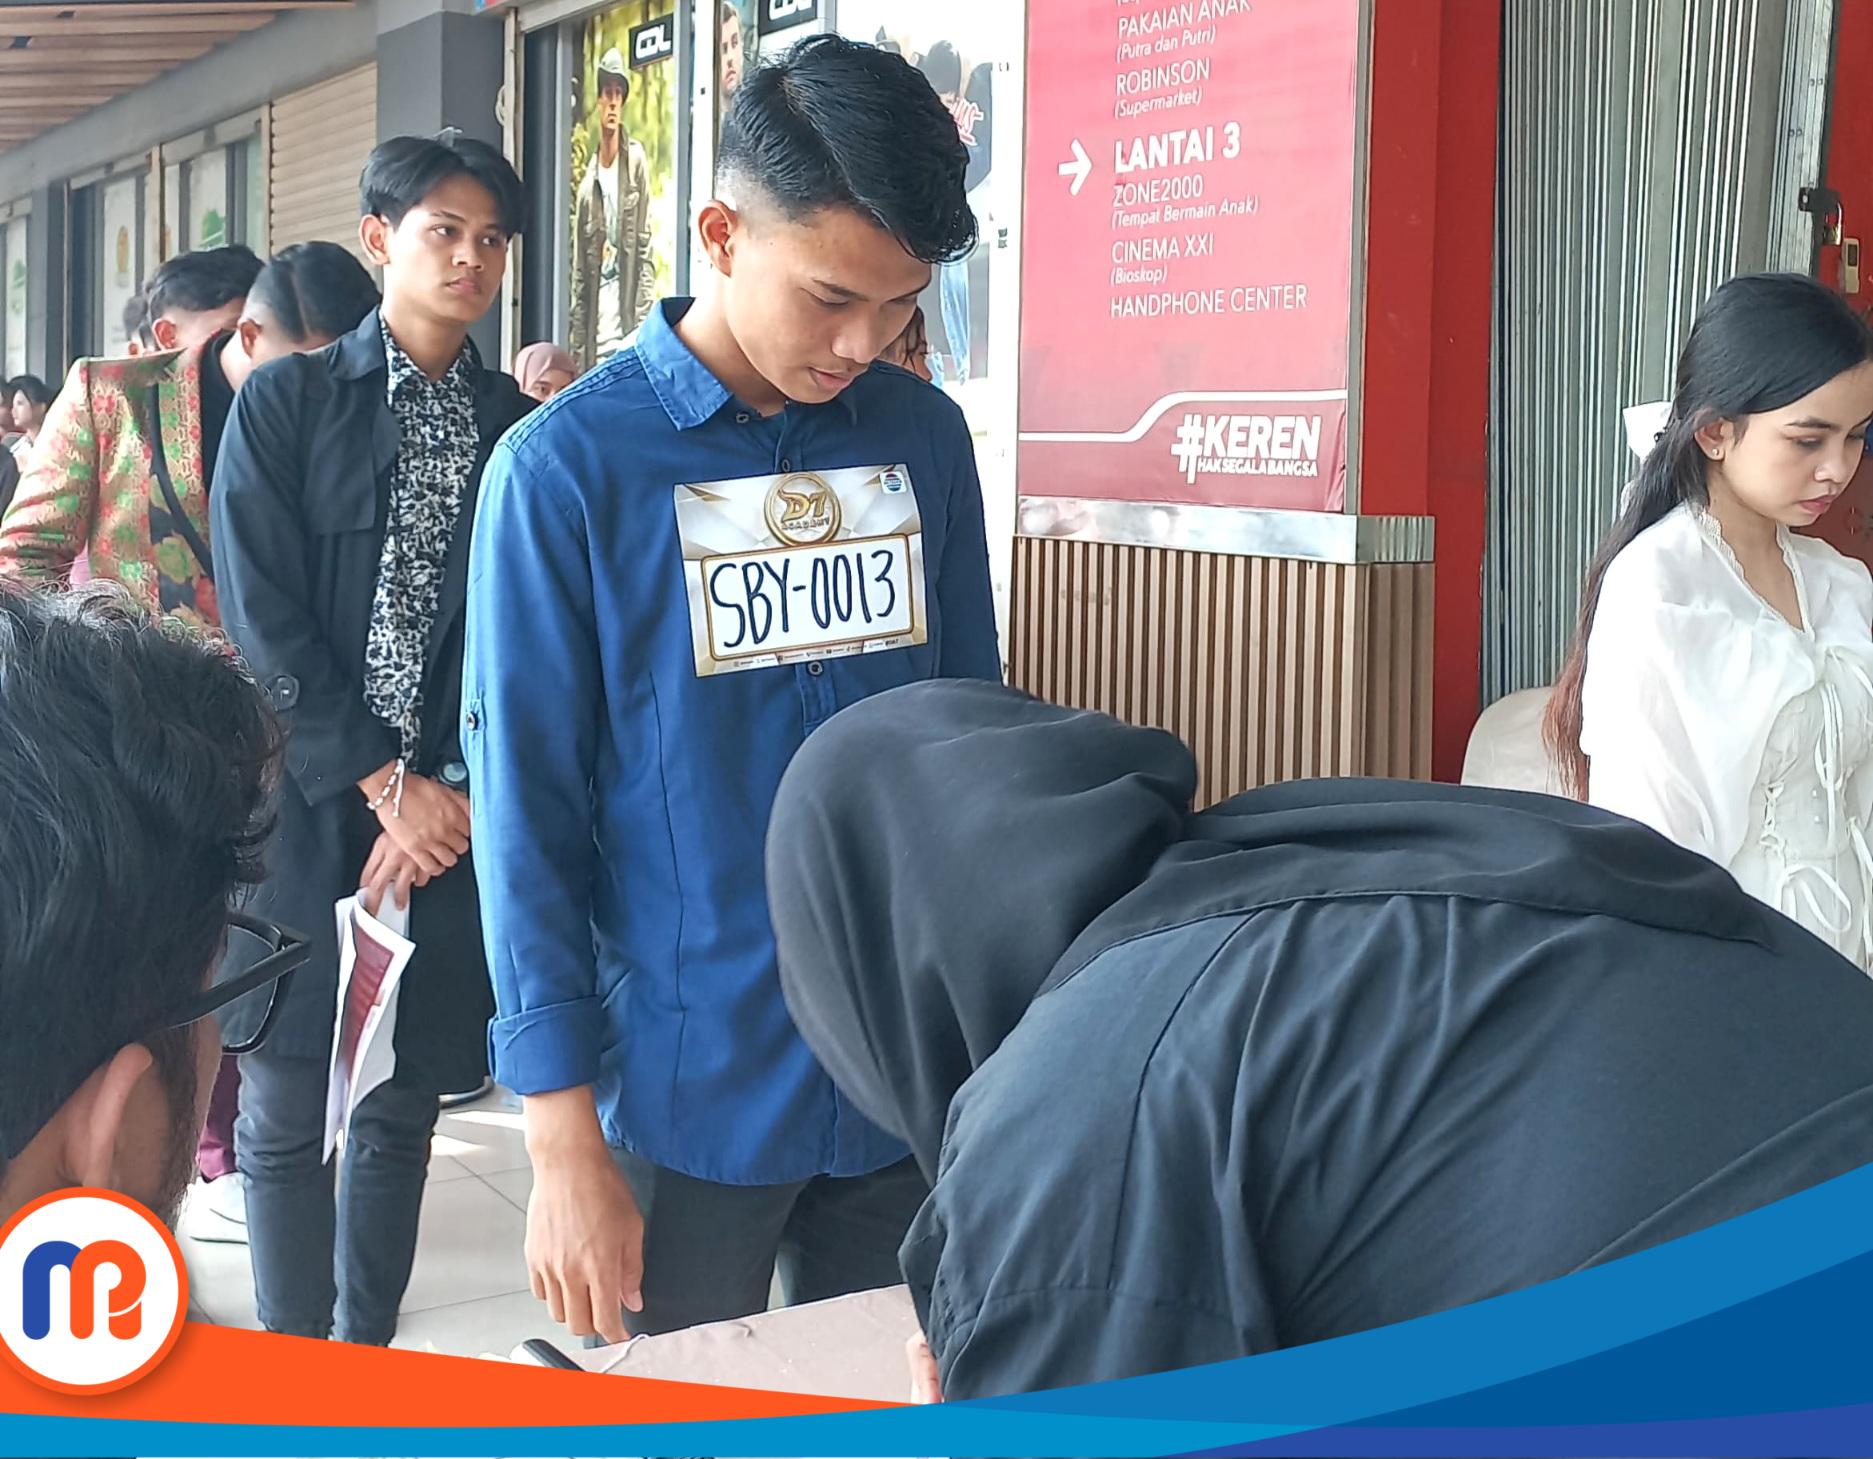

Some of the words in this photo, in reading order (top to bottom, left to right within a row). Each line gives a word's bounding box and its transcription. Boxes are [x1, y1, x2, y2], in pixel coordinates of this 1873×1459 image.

[1118, 4, 1194, 39] PAKAIAN
[1116, 43, 1152, 64] (Putra
[1155, 35, 1178, 53] dan
[1182, 25, 1216, 47] Putri)
[1116, 57, 1211, 97] ROBINSON
[1114, 86, 1203, 120] (Supermarket)
[1114, 126, 1214, 174] LANTAI
[1222, 121, 1241, 159] 3
[1112, 174, 1204, 208] ZONE2000
[1112, 209, 1160, 230] (Tempat
[1163, 202, 1216, 223] Bermain
[1219, 195, 1259, 215] Anak)
[1111, 236, 1181, 264] CINEMA
[1184, 232, 1214, 257] XXI
[1110, 264, 1168, 287] (Bioskop)
[1111, 288, 1225, 319] HANDPHONE
[1230, 284, 1307, 313] CENTER
[1171, 414, 1322, 484] #KEREN
[709, 549, 897, 648] SBY-0013
